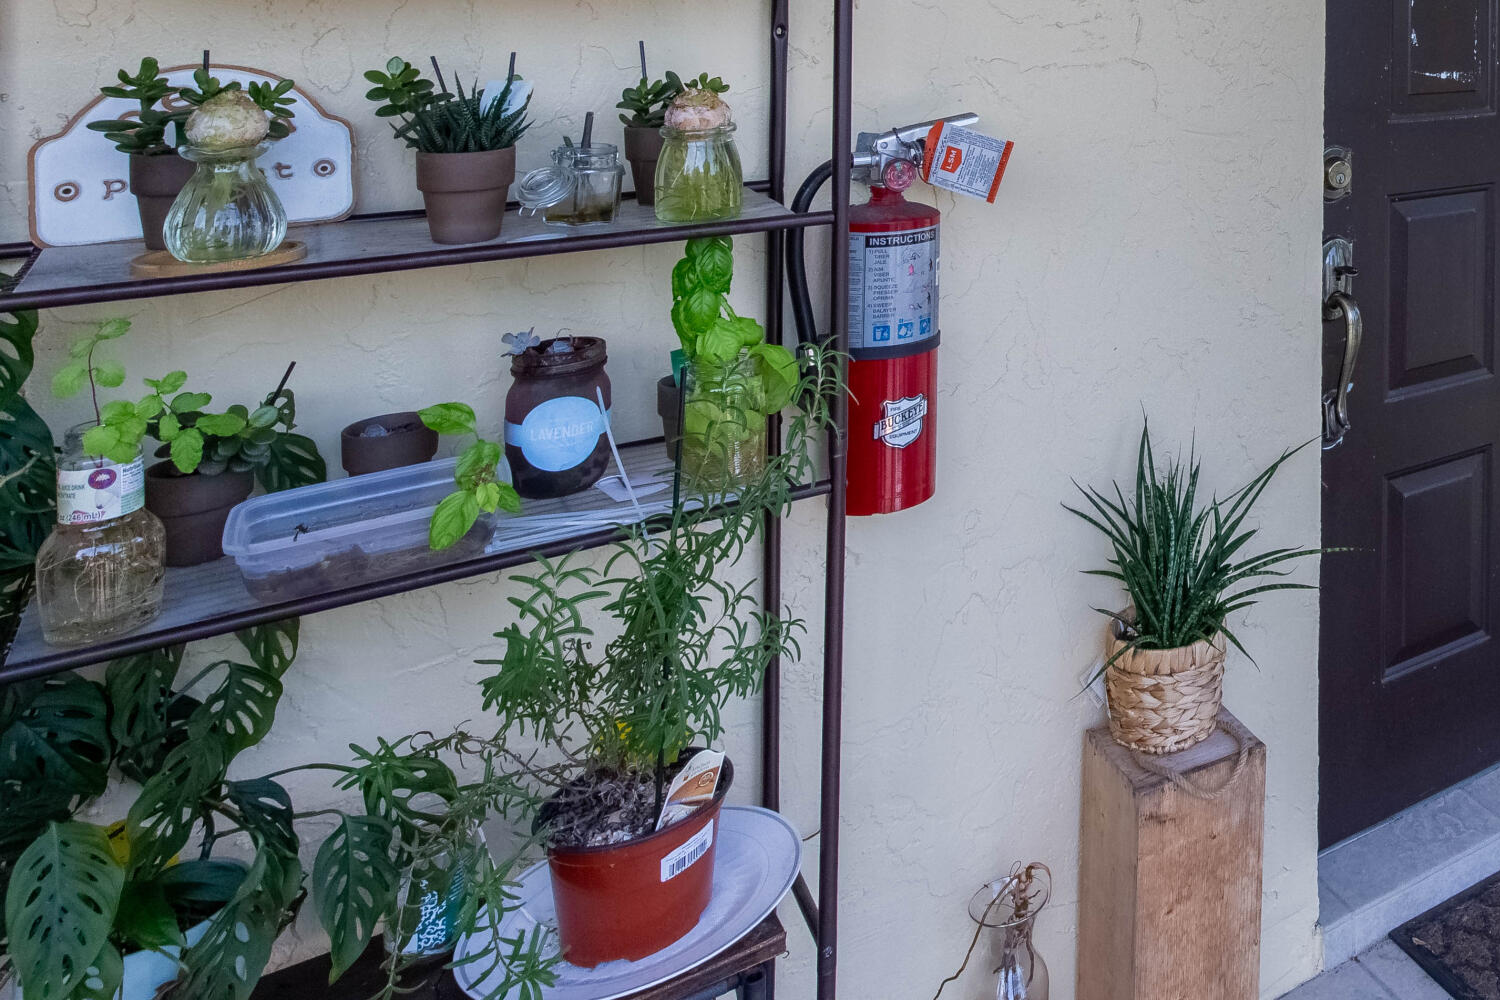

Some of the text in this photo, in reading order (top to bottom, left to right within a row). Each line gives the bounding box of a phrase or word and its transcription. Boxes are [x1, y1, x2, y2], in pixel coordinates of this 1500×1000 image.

[869, 231, 935, 247] INSTRUCTIONS
[881, 403, 923, 431] BUCKEYE
[530, 421, 593, 441] LAVENDER
